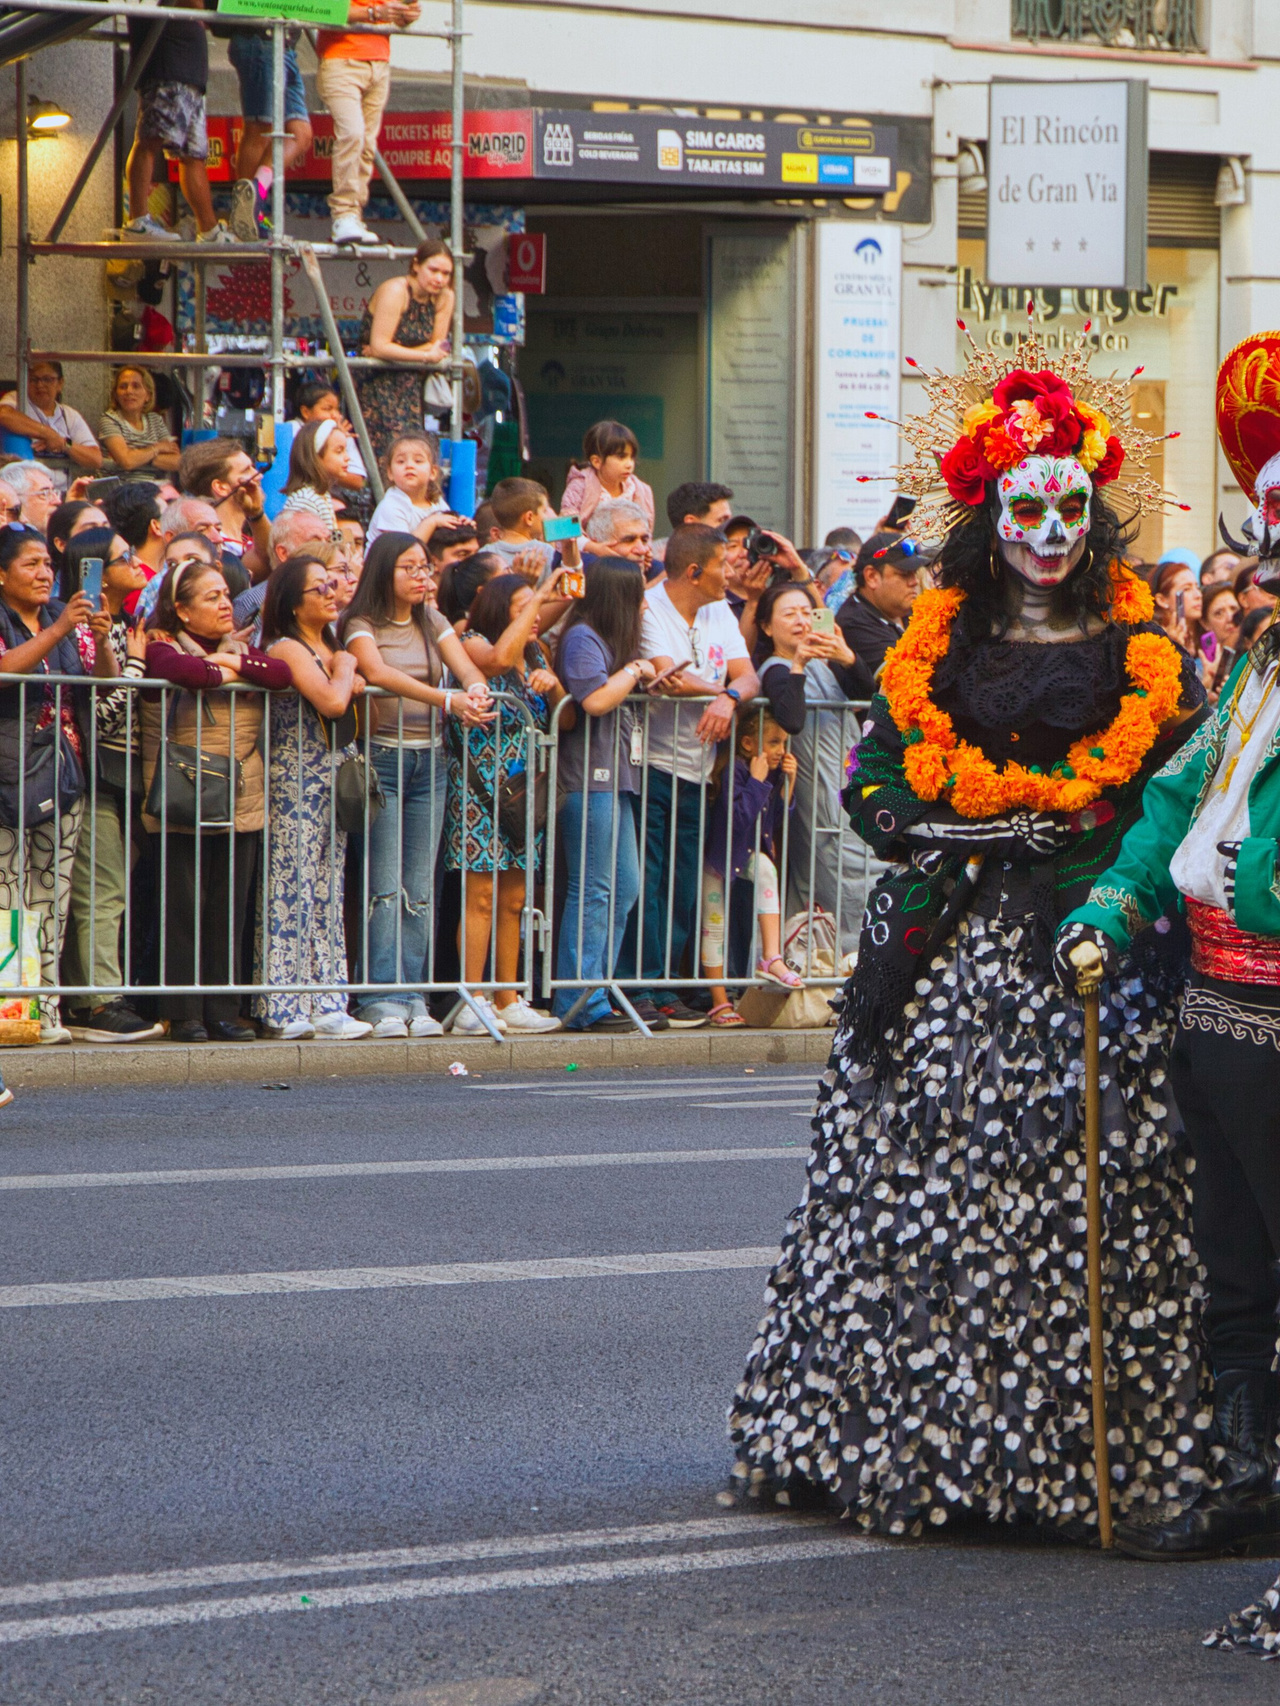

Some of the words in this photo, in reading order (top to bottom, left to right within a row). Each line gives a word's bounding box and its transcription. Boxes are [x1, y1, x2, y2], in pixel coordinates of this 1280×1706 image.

[384, 123, 430, 141] TICKETS
[431, 123, 452, 140] HER
[1000, 115, 1026, 146] El
[1033, 114, 1120, 146] Rincón
[468, 133, 526, 155] MADRID
[686, 130, 713, 149] SIM
[714, 132, 766, 151] CARDS
[384, 149, 431, 166] COMPRE
[433, 151, 452, 169] AQ
[578, 149, 598, 160] COLD
[686, 158, 742, 175] TARJETAS
[743, 161, 765, 176] SIM
[998, 173, 1022, 203] de
[1027, 172, 1078, 204] Gran
[834, 282, 872, 296] GRAN
